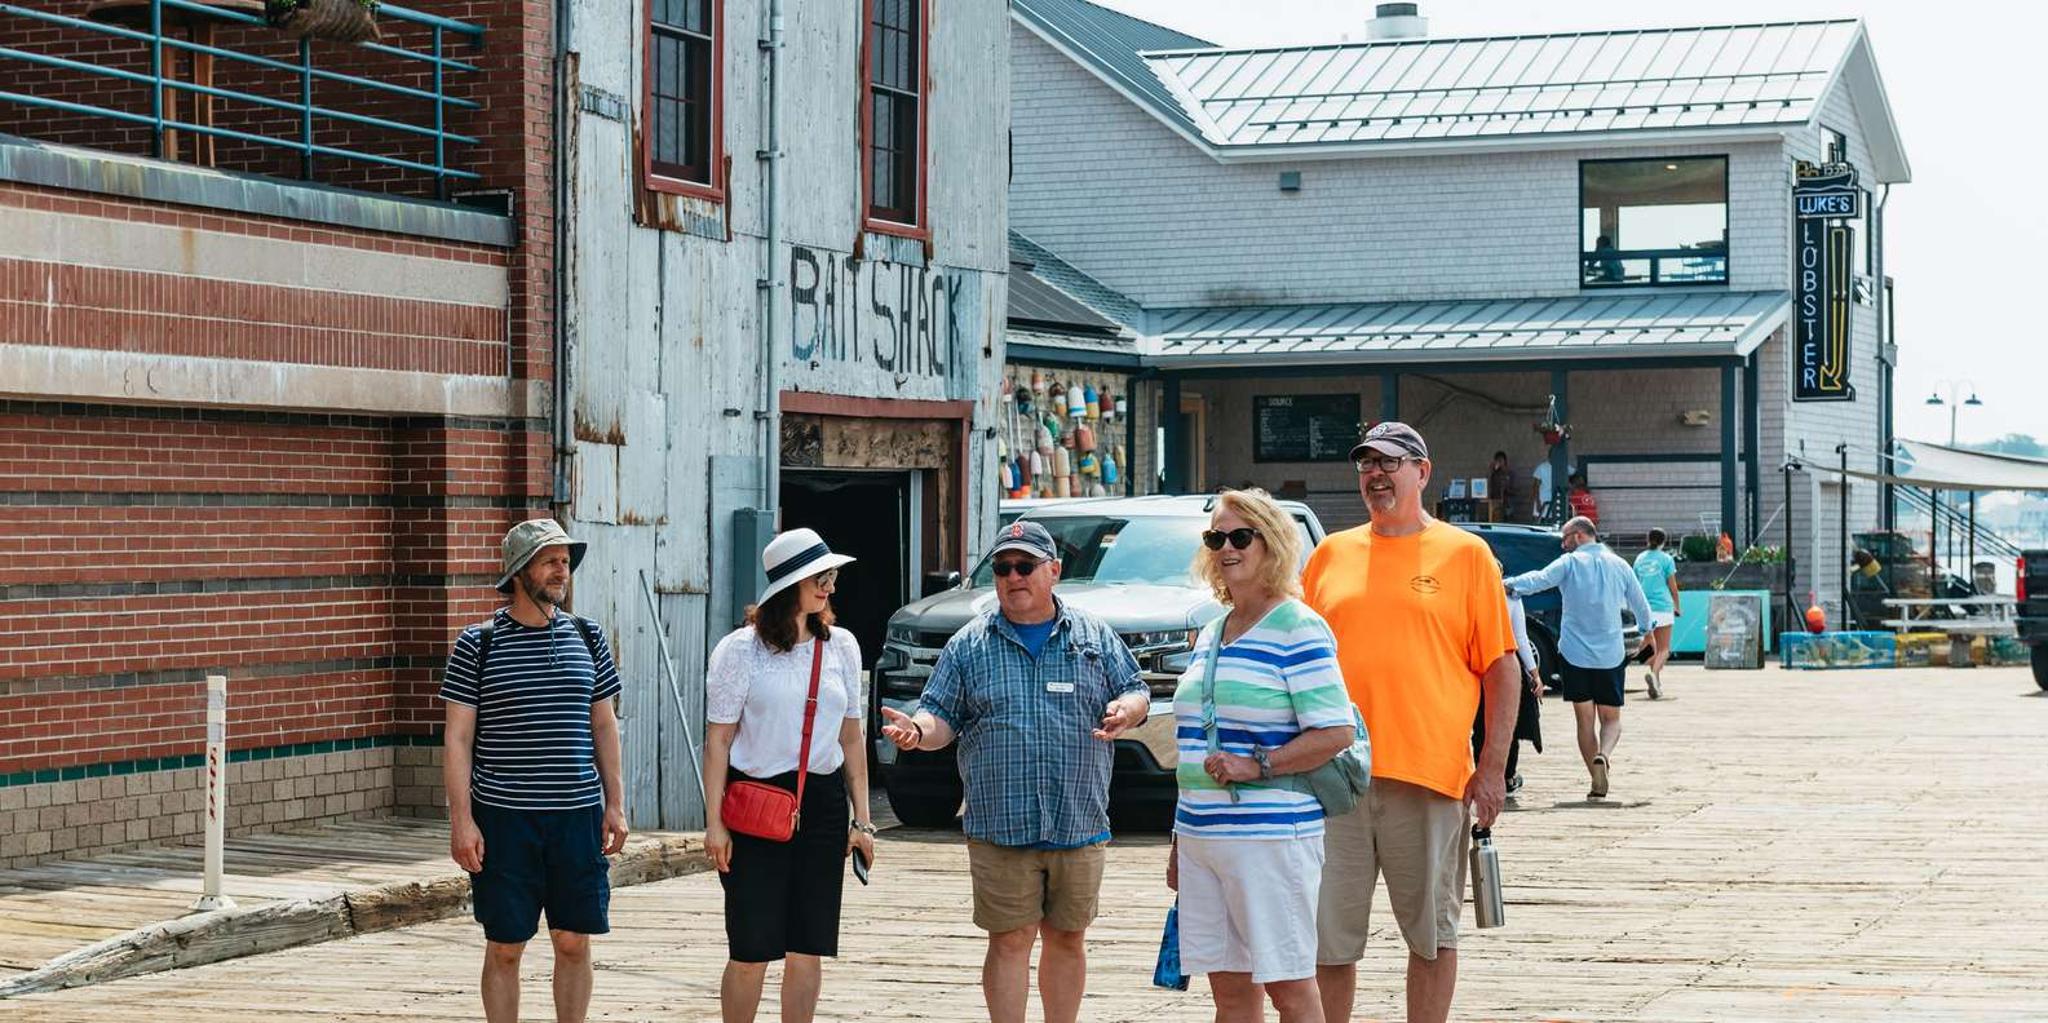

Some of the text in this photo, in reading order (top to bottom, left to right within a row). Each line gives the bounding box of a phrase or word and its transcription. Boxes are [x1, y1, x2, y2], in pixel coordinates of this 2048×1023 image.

[1800, 196, 1850, 213] LUKE'S
[791, 246, 964, 379] BAIT SHACK
[1802, 222, 1817, 389] LOBSTER
